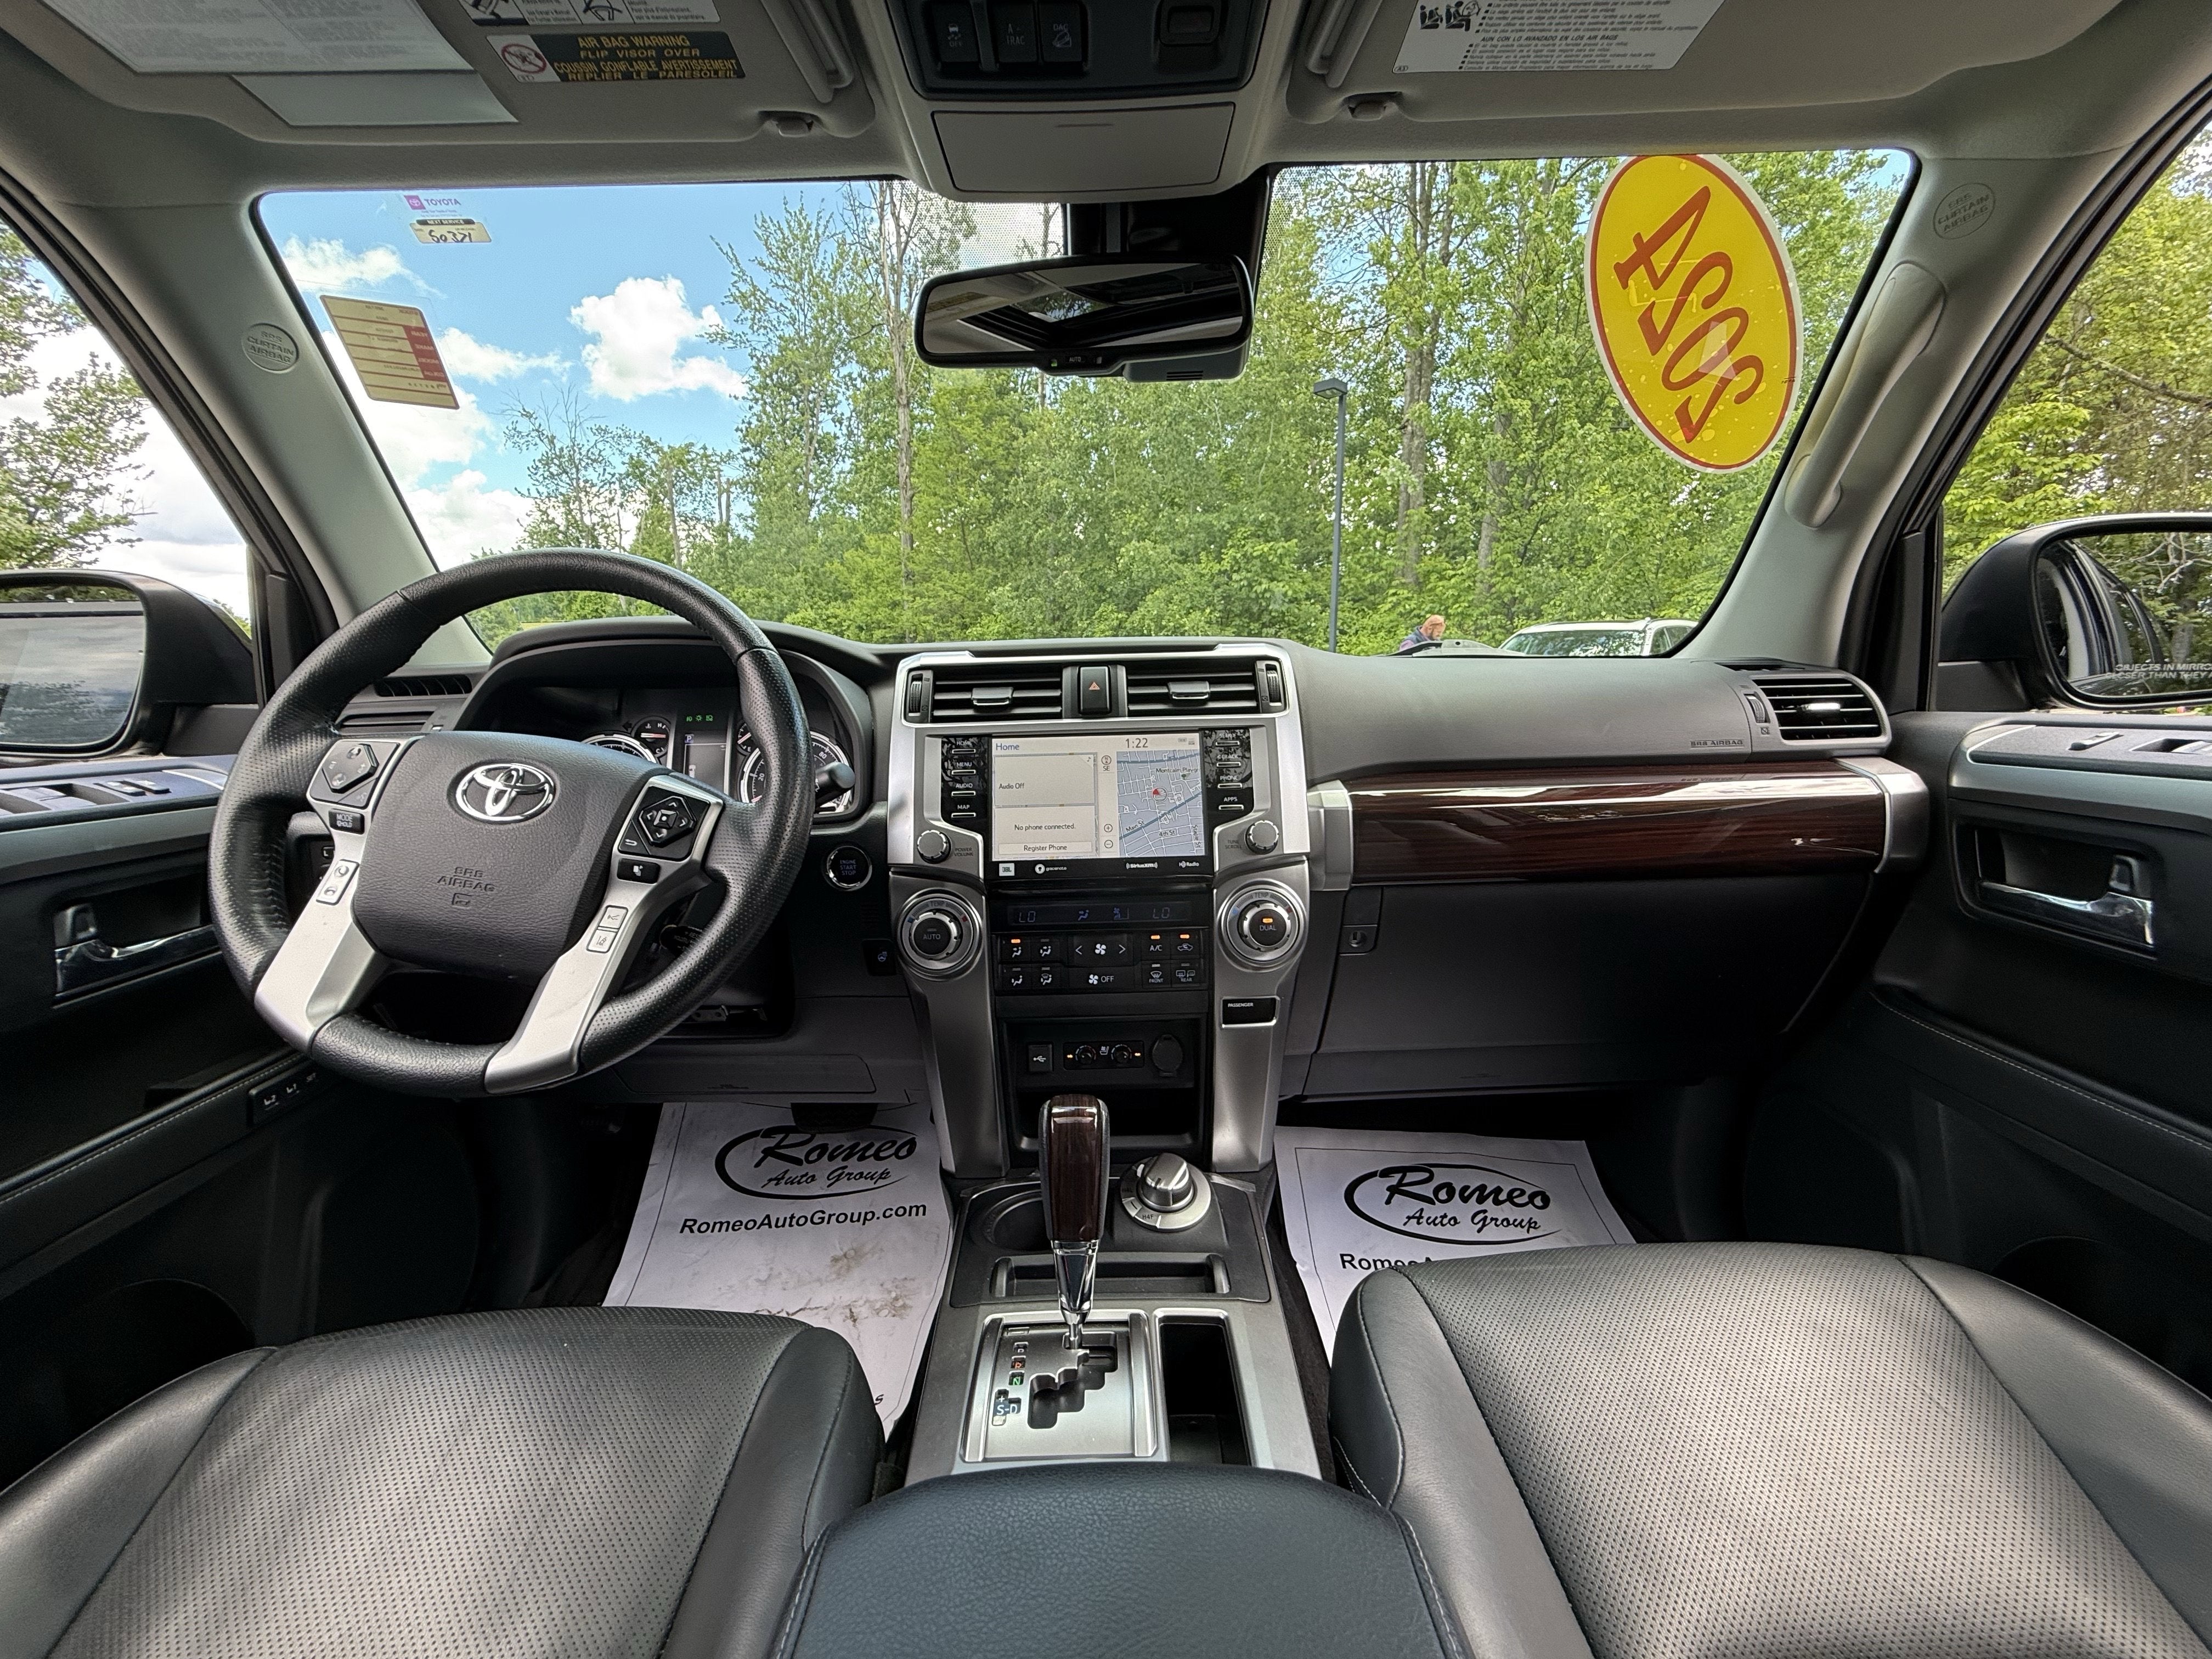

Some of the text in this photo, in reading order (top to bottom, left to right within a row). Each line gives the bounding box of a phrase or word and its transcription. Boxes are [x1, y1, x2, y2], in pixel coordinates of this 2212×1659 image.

[1053, 24, 1068, 32] DAC
[577, 35, 691, 48] AIR BAG WARNING
[579, 48, 700, 59] FLIP VISOR OVER
[553, 59, 738, 74] COUSSIN GONFLABLE AVERTISSEMENT
[567, 70, 737, 81] REPLIER LE PARESOLEIL
[1938, 195, 1990, 225] CURTAIN
[1943, 205, 1989, 232] AIRBAG
[247, 336, 295, 357] CURTAIN
[250, 345, 291, 363] AIRBAG
[995, 743, 1020, 751] Home
[1125, 738, 1149, 748] 1:22
[819, 751, 827, 759] 80
[758, 773, 765, 781] 20
[336, 814, 353, 822] MODE
[1125, 823, 1139, 832] Main
[437, 876, 496, 892] AIRBAG
[753, 1125, 917, 1168] Romeo
[761, 1165, 891, 1189] Auto Group
[1378, 1164, 1551, 1210] Romeo
[679, 1203, 927, 1234] RomeoAutoGroup.com
[1408, 1207, 1542, 1234] Auto Group
[1012, 1377, 1021, 1386] N
